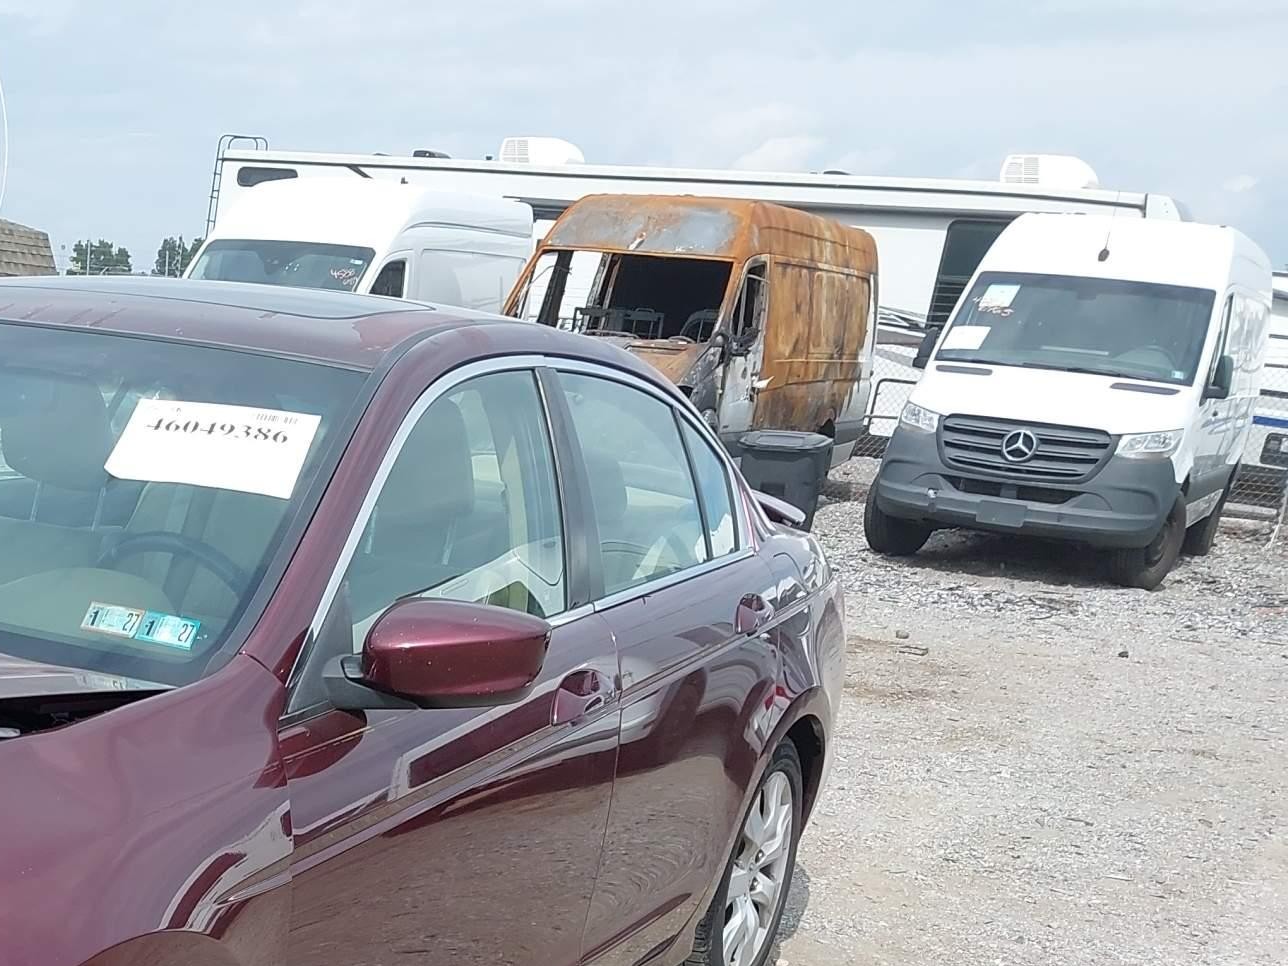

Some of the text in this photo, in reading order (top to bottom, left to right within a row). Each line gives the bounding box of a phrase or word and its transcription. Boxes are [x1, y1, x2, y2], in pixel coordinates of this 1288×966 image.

[146, 417, 289, 444] 46049386
[122, 612, 141, 633] 27
[177, 623, 195, 643] 27
